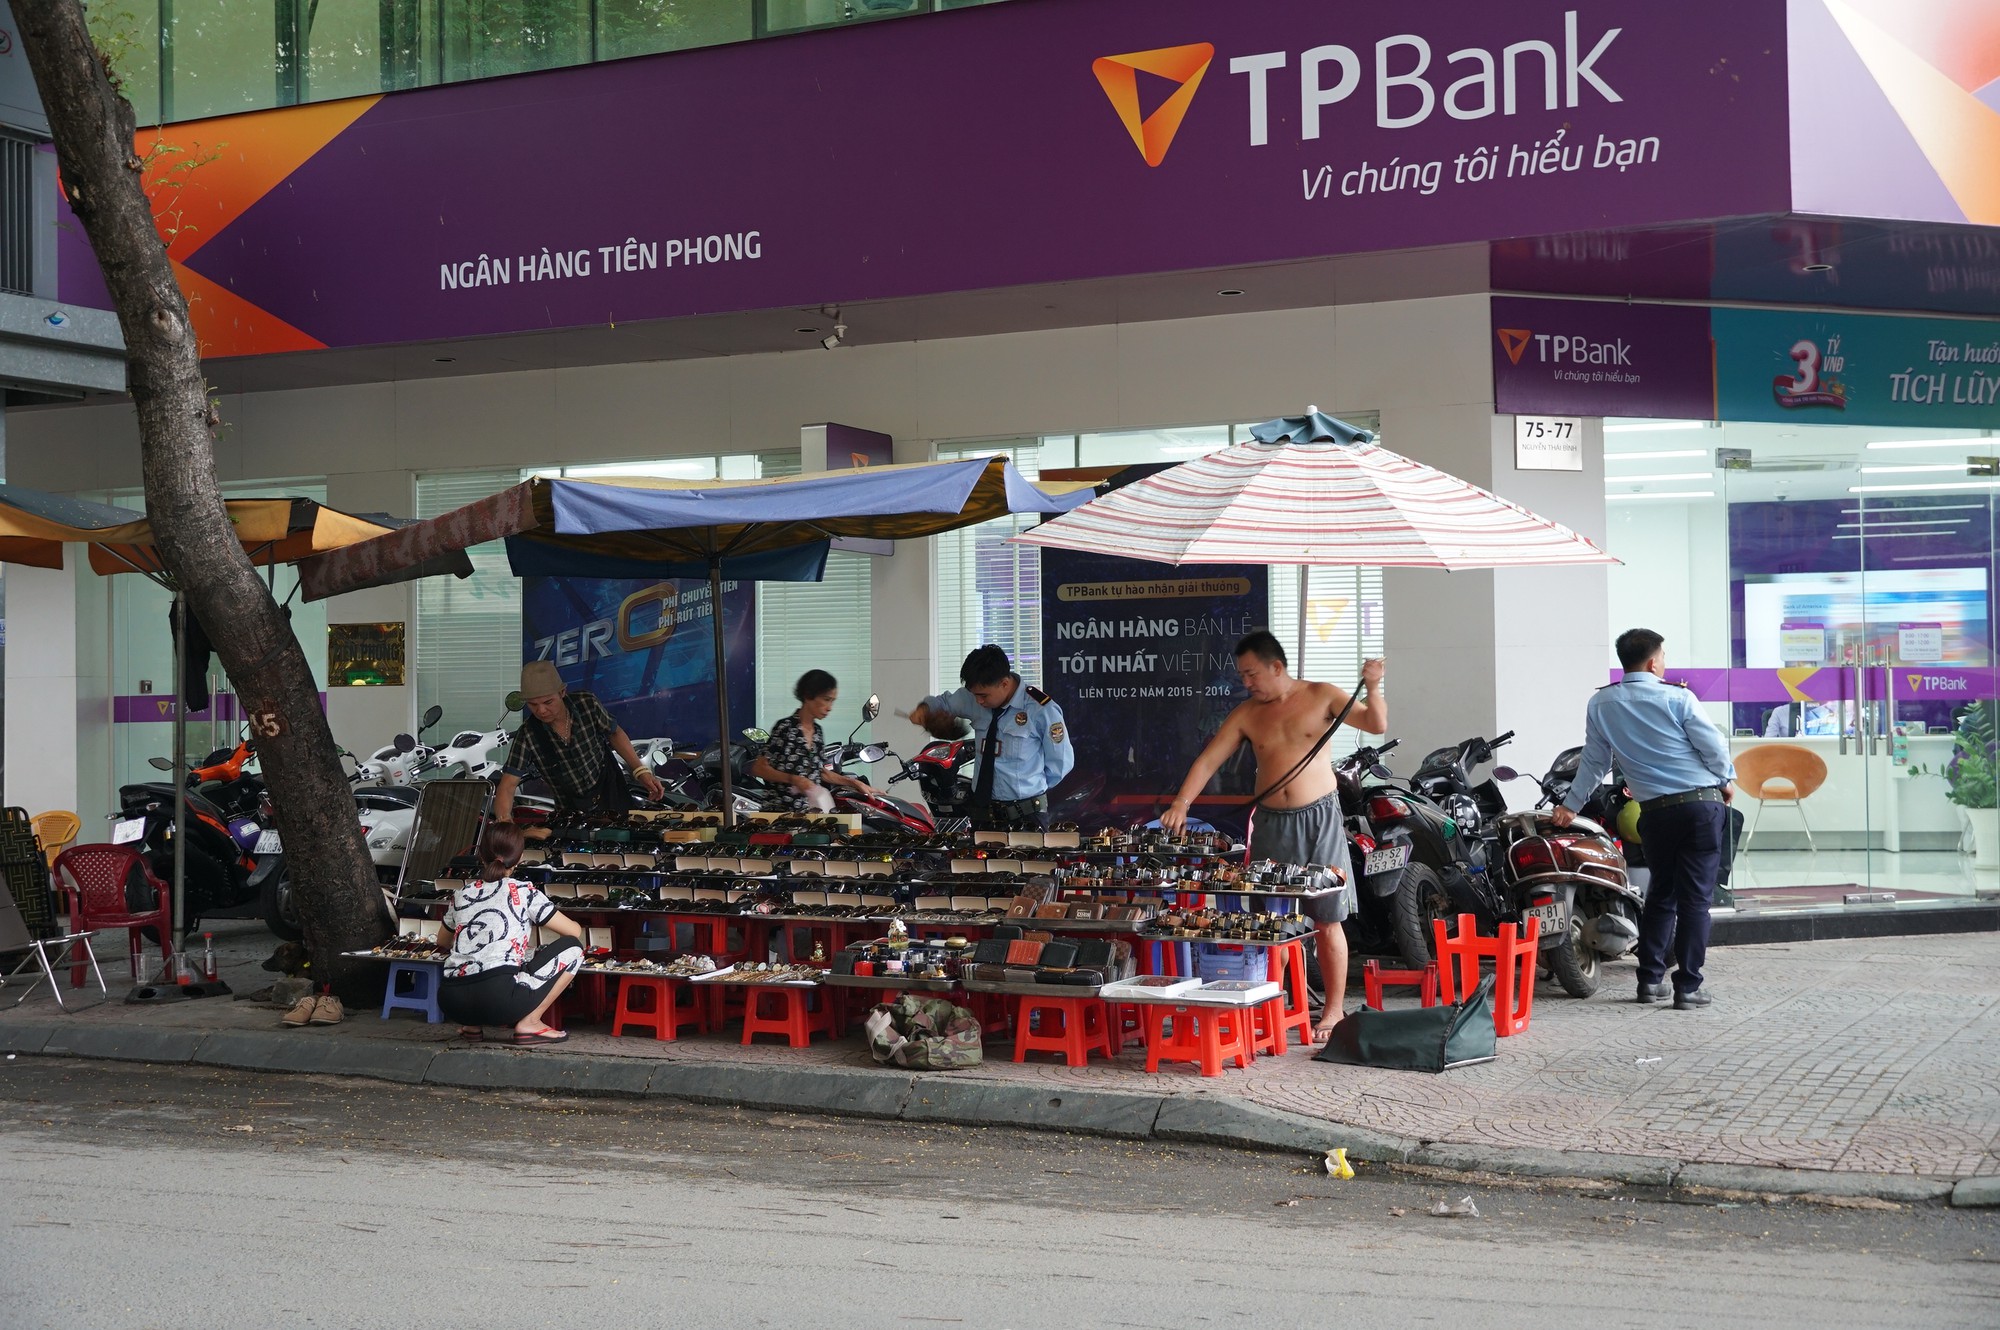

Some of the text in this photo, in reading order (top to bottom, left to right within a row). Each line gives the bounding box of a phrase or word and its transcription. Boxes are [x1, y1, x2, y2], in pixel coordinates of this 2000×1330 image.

[1229, 10, 1624, 147] TPBank
[1302, 129, 1660, 200] Vì chúng tôi hiểu bạn
[440, 231, 761, 290] NGÂN HÀNG TIÊN PHONG
[1534, 334, 1632, 366] TPBank
[1927, 340, 1960, 366] Tận
[1564, 370, 1590, 383] chúng
[1592, 371, 1604, 382] tôi
[1605, 369, 1624, 382] hiểu
[1625, 373, 1641, 384] bạn
[1789, 338, 1822, 394] 3
[1823, 356, 1844, 372] VNĐ
[1889, 366, 2000, 404] TÍCH LŨY
[662, 591, 679, 610] PHÍ
[1066, 581, 1240, 598] TPBank tự hào nhận giải thưởng
[1056, 617, 1114, 640] NGÂN
[1119, 616, 1179, 638] HÀNG
[1184, 613, 1224, 636] BÁN
[1058, 650, 1098, 674] TỐT
[1102, 648, 1158, 673] NHẤT
[1162, 650, 1204, 675] VIỆT
[1079, 685, 1103, 699] LIÊN
[1106, 687, 1128, 700] TỤC
[1130, 687, 1137, 698] 2
[1139, 684, 1165, 698] NĂM
[1167, 686, 1193, 697] 2015
[1204, 685, 1231, 697] 2016
[1923, 675, 1968, 691] TPBank
